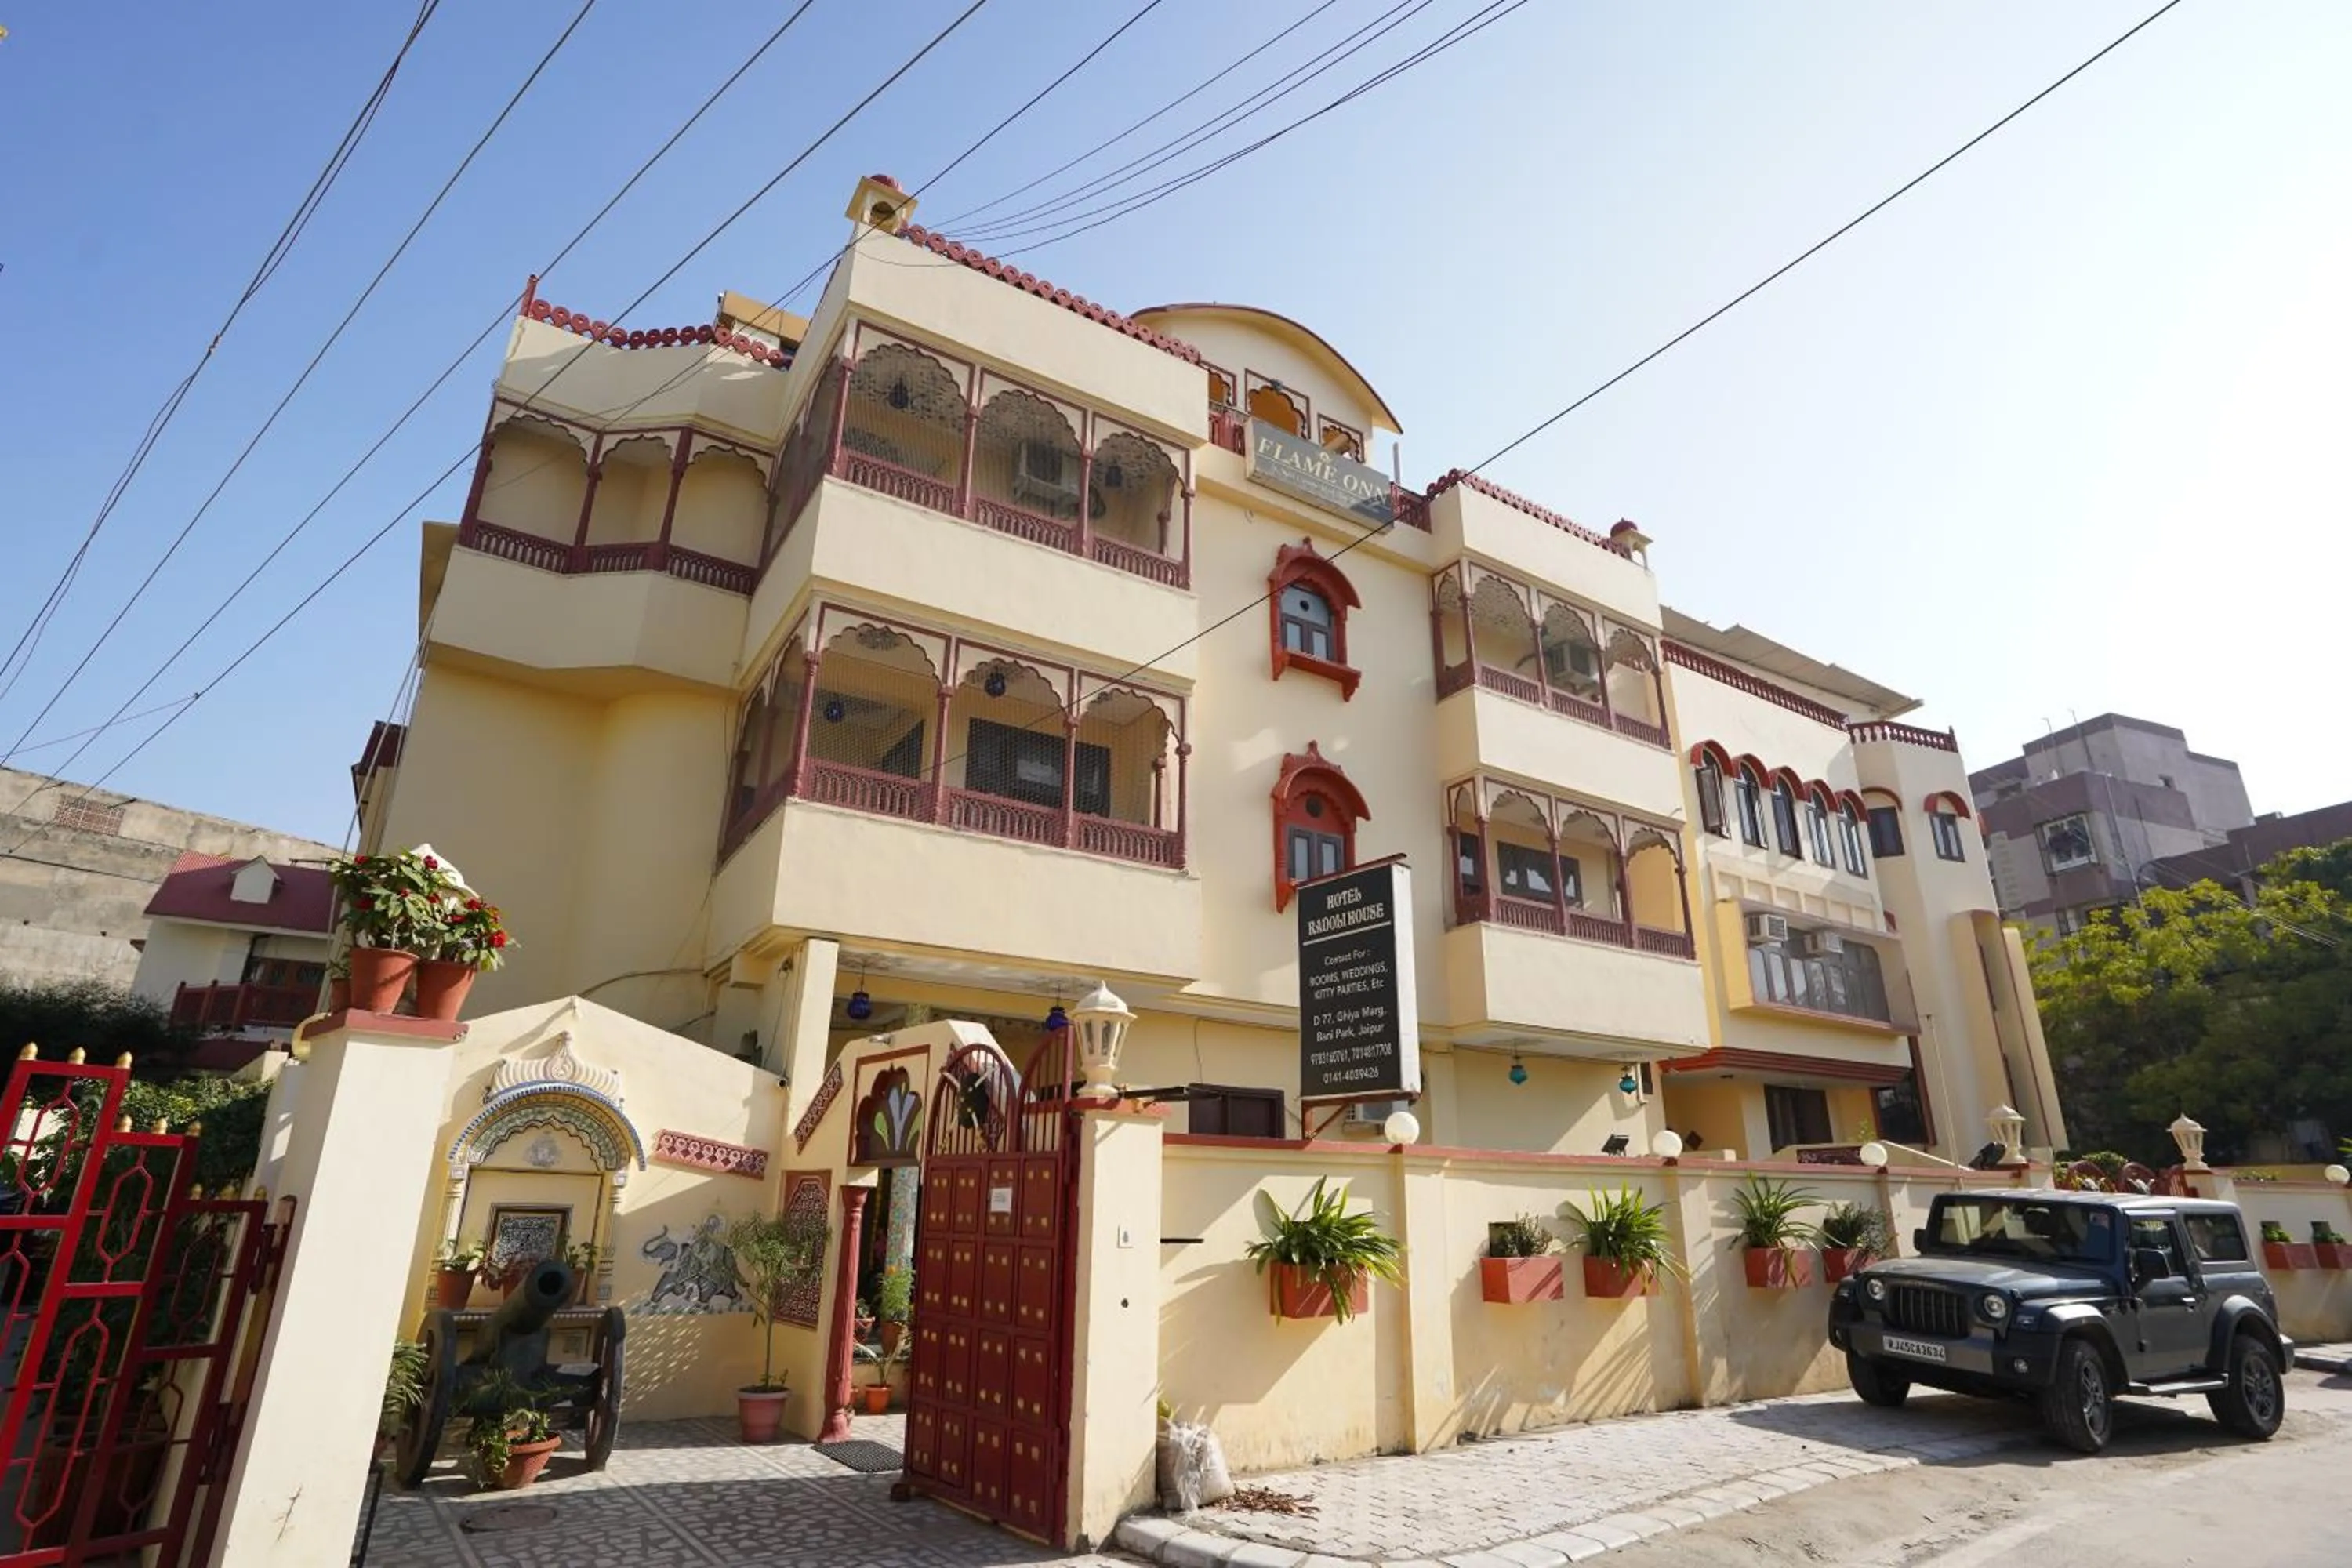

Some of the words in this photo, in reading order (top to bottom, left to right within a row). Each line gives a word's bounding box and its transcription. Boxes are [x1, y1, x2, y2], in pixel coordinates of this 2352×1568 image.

[1258, 437, 1338, 483] FLAME
[1327, 887, 1362, 909] HOTEL
[1348, 903, 1385, 925] HOUSE
[1324, 953, 1352, 966] Contact
[1314, 987, 1334, 1000] KITTY
[1313, 1016, 1320, 1026] D
[1316, 1030, 1333, 1042] Bani
[1358, 1023, 1385, 1036] Jaipur
